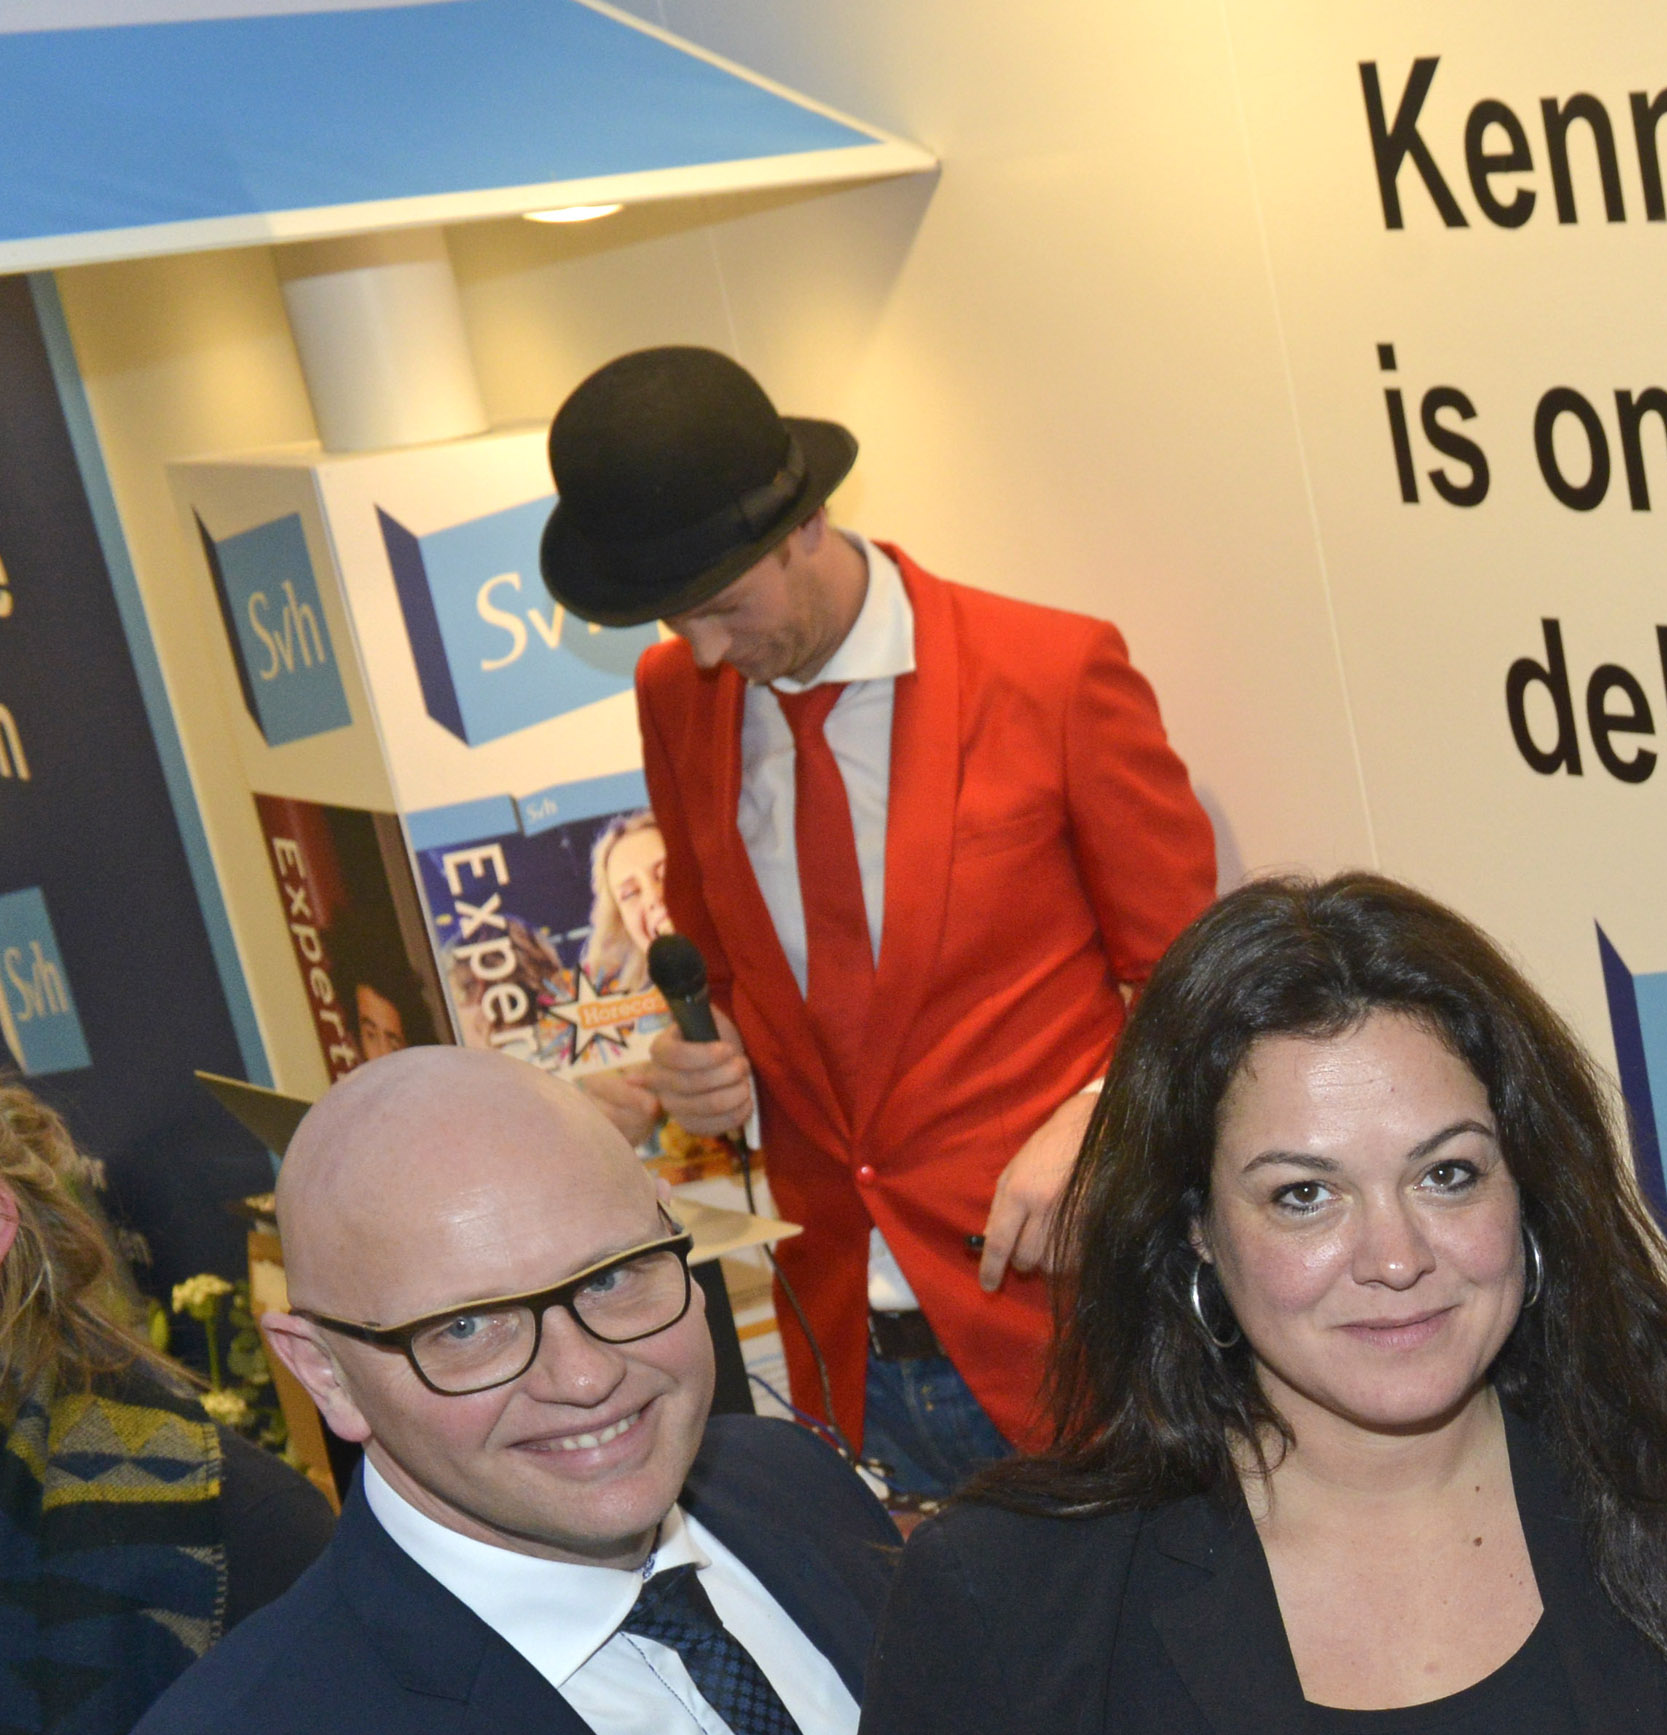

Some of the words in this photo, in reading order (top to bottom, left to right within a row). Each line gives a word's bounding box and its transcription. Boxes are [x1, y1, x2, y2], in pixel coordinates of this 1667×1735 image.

[1375, 342, 1492, 508] is
[248, 579, 326, 681] Svh
[476, 572, 602, 672] Sv
[272, 837, 356, 1082] Expert
